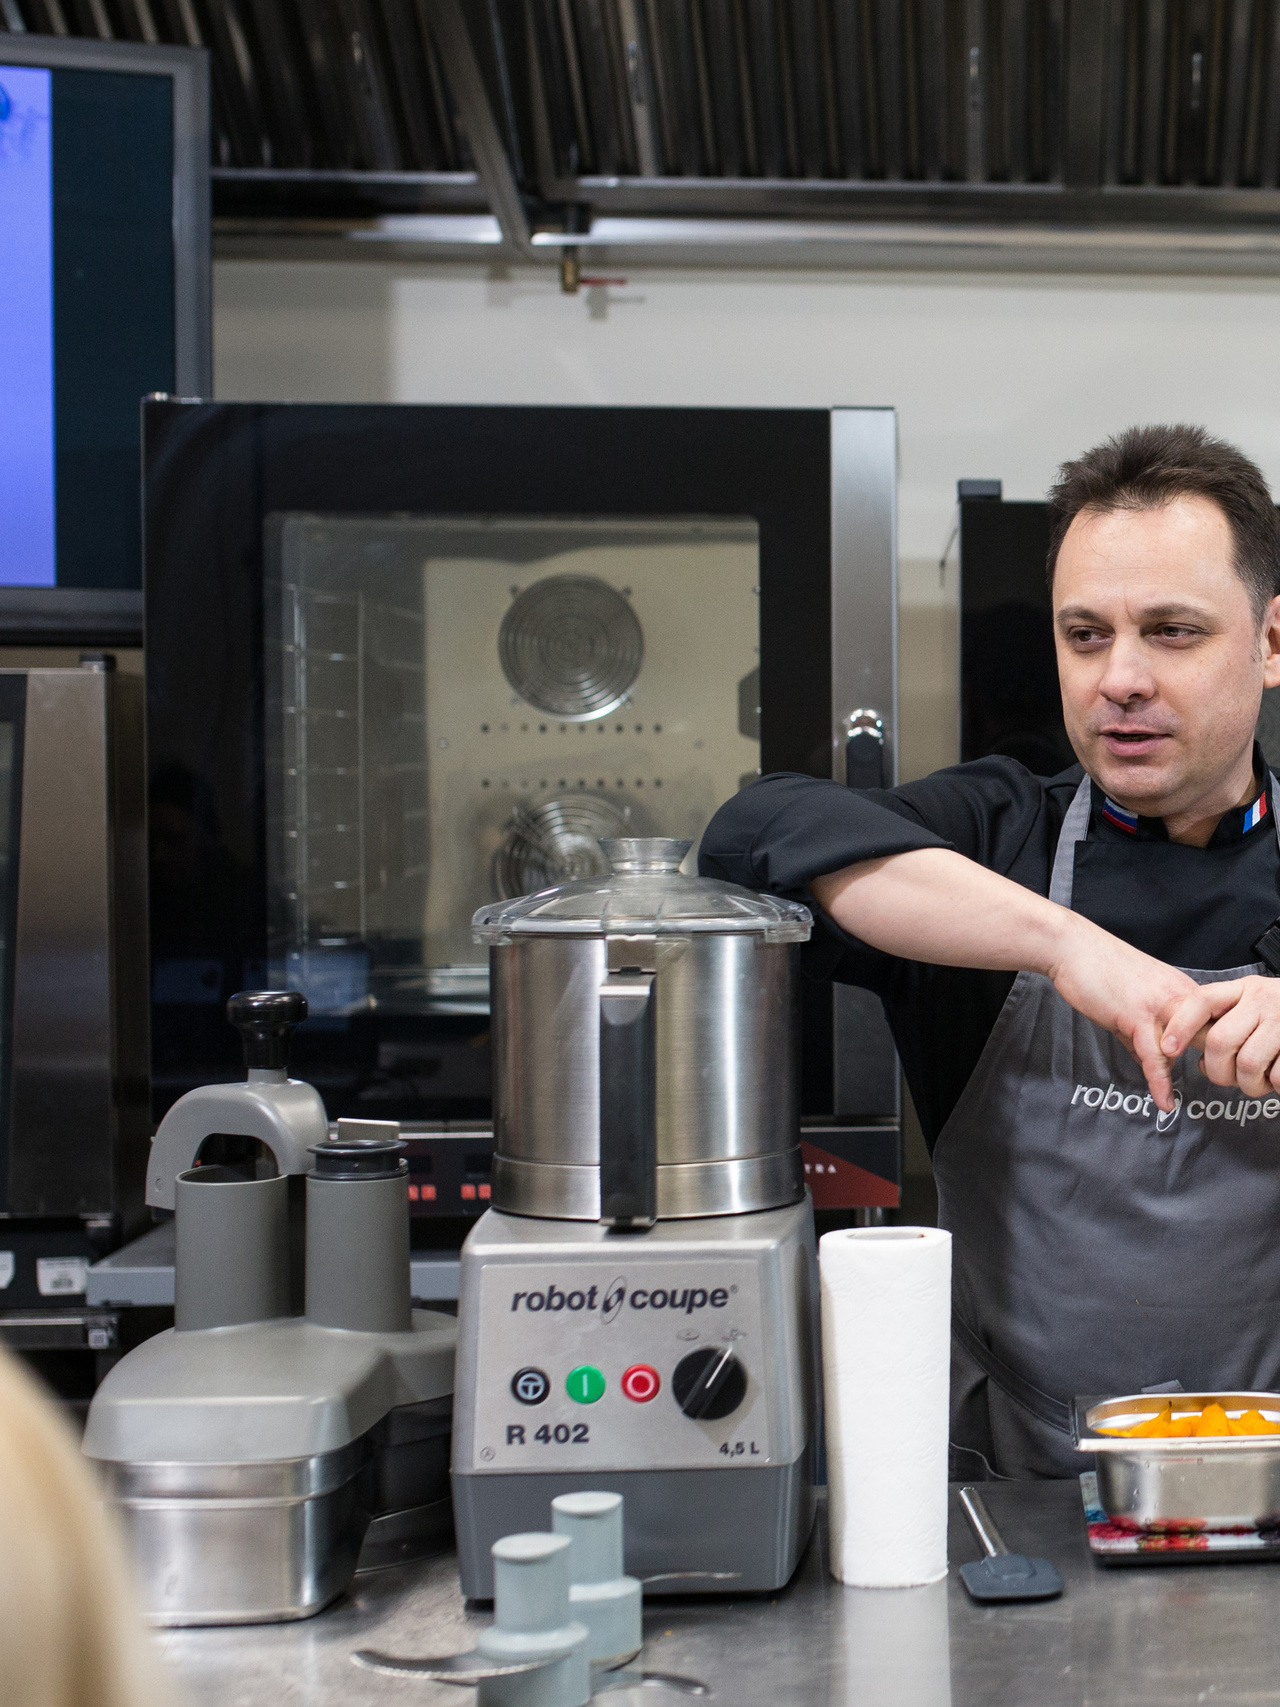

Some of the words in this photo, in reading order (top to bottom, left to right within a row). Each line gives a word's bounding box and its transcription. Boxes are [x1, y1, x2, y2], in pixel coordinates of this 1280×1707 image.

[1070, 1083, 1154, 1118] robot
[510, 1284, 599, 1313] robot
[505, 1424, 527, 1446] R
[533, 1423, 591, 1445] 402
[718, 1441, 746, 1459] 4,5
[750, 1441, 761, 1455] L
